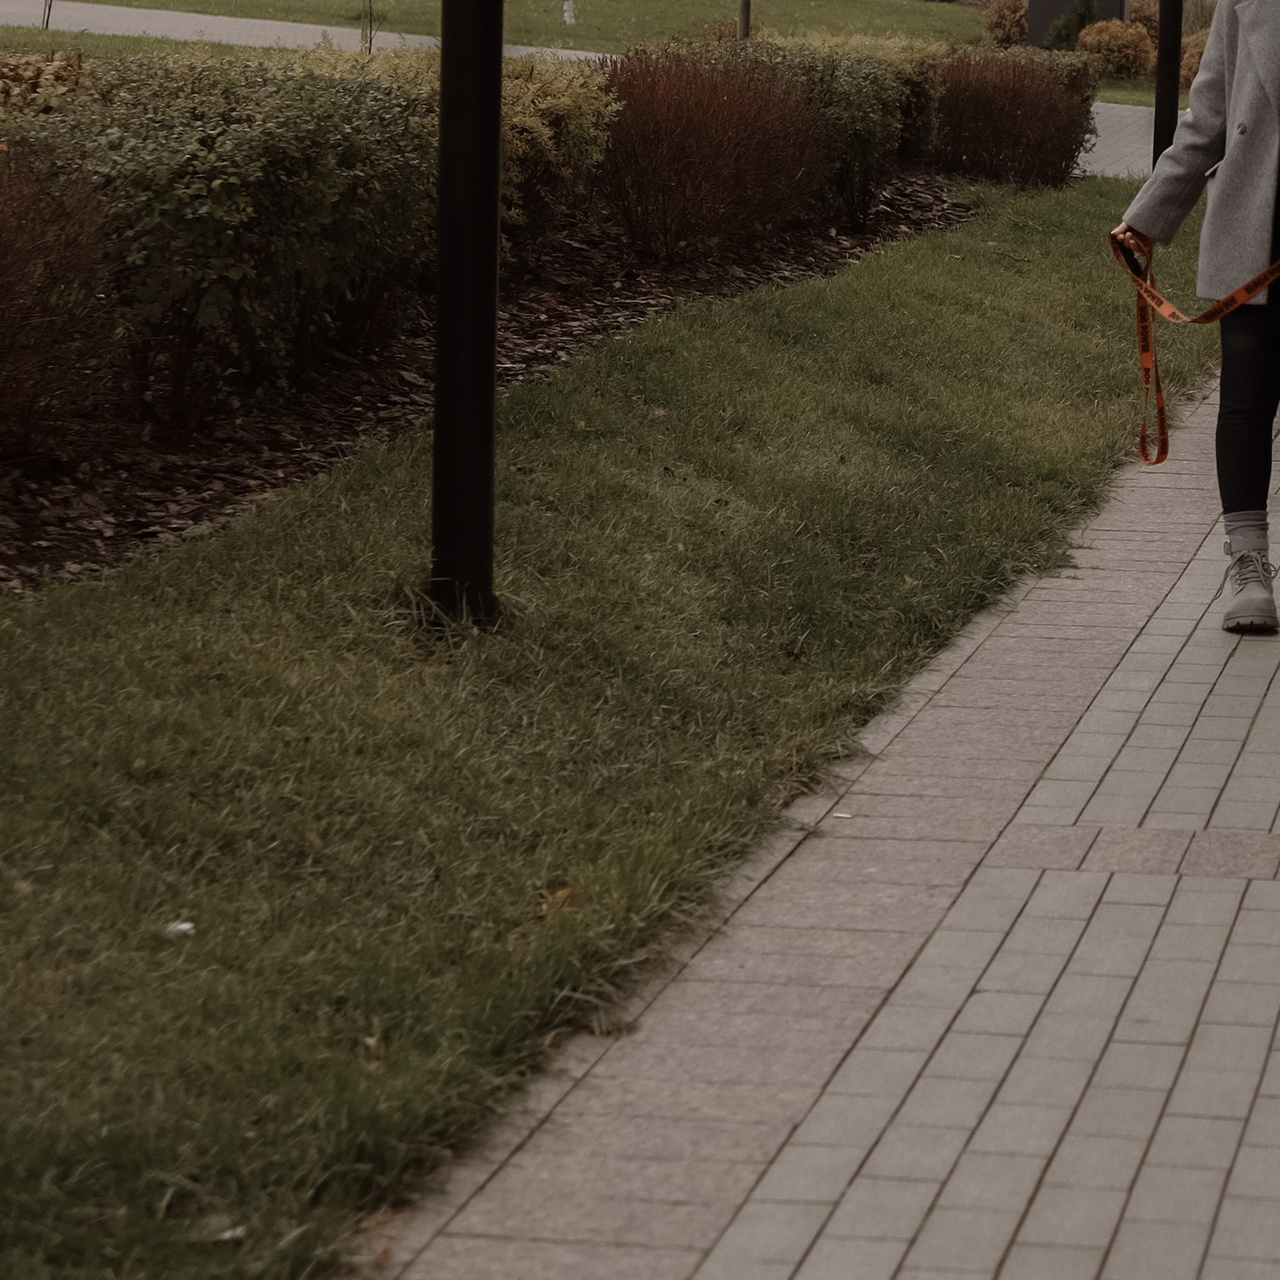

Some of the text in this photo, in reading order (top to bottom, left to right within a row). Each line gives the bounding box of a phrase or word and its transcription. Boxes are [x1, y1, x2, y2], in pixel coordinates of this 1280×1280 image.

[1143, 286, 1164, 309] POWER
[1139, 324, 1150, 353] POWER
[1143, 367, 1151, 385] DOG
